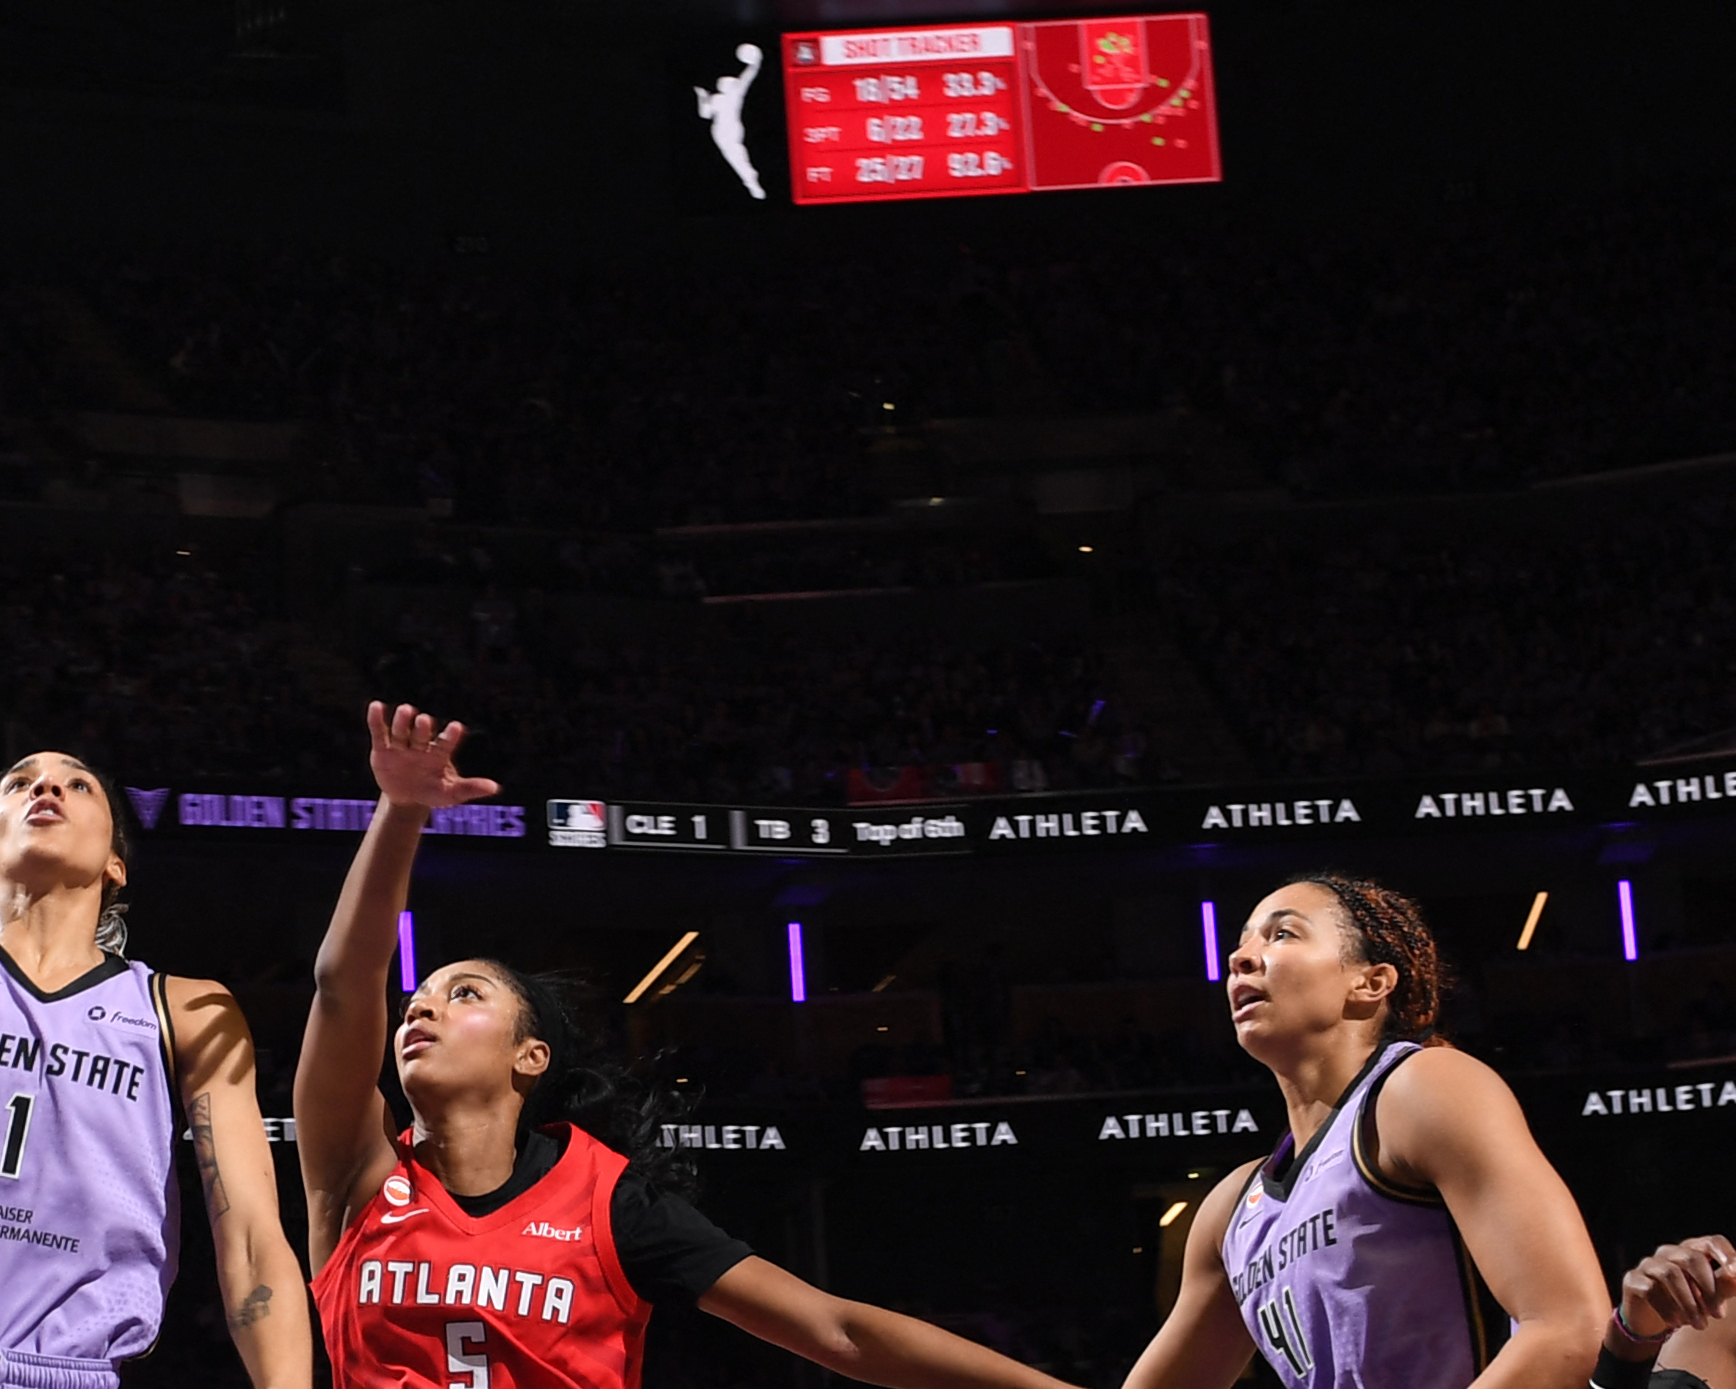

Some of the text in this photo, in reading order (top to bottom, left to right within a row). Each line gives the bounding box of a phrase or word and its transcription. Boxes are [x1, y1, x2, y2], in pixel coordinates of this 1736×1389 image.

[843, 32, 982, 58] SHOT TRACKER
[1414, 788, 1574, 819] ATHLETA
[1628, 771, 1736, 808] ATHLE
[178, 793, 286, 829] GOLDEN
[625, 813, 708, 840] CLE 1
[988, 809, 1149, 840] ATHLETA
[1202, 799, 1362, 830] ATHLETA
[753, 818, 830, 844] TB 3
[852, 821, 896, 846] Top
[898, 816, 924, 840] of
[109, 1010, 158, 1031] freedom
[44, 1042, 145, 1103] STATE
[655, 1123, 787, 1150] THLETA
[859, 1119, 1019, 1151] ATHLETA
[1098, 1108, 1259, 1141] ATHLETA
[521, 1220, 583, 1242] Albert
[1278, 1208, 1338, 1273] STATE
[358, 1259, 575, 1325] ATLANTA
[1257, 1285, 1315, 1380] 41
